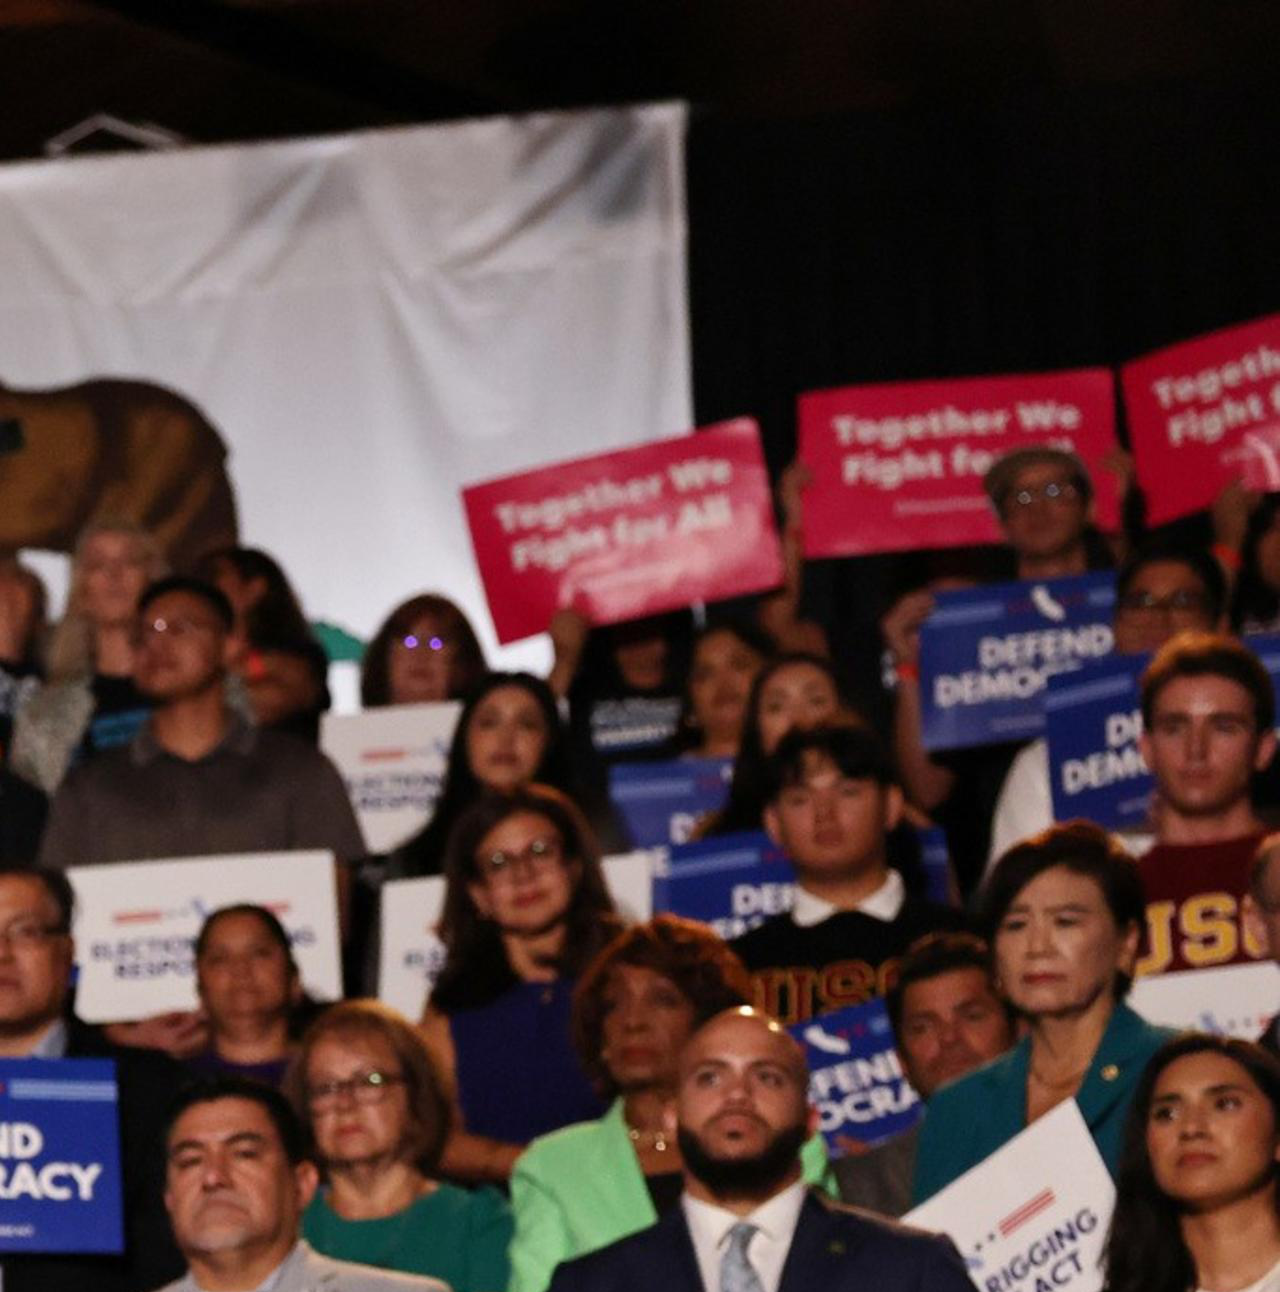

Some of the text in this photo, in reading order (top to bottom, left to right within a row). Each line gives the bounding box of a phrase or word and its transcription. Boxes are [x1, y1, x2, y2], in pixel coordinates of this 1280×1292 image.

[1153, 345, 1280, 410] Togeth
[833, 405, 1008, 448] Together
[1017, 402, 1081, 431] We
[844, 444, 995, 490] Fight fo
[495, 458, 732, 534] Together We
[977, 623, 1115, 670] DEFEND
